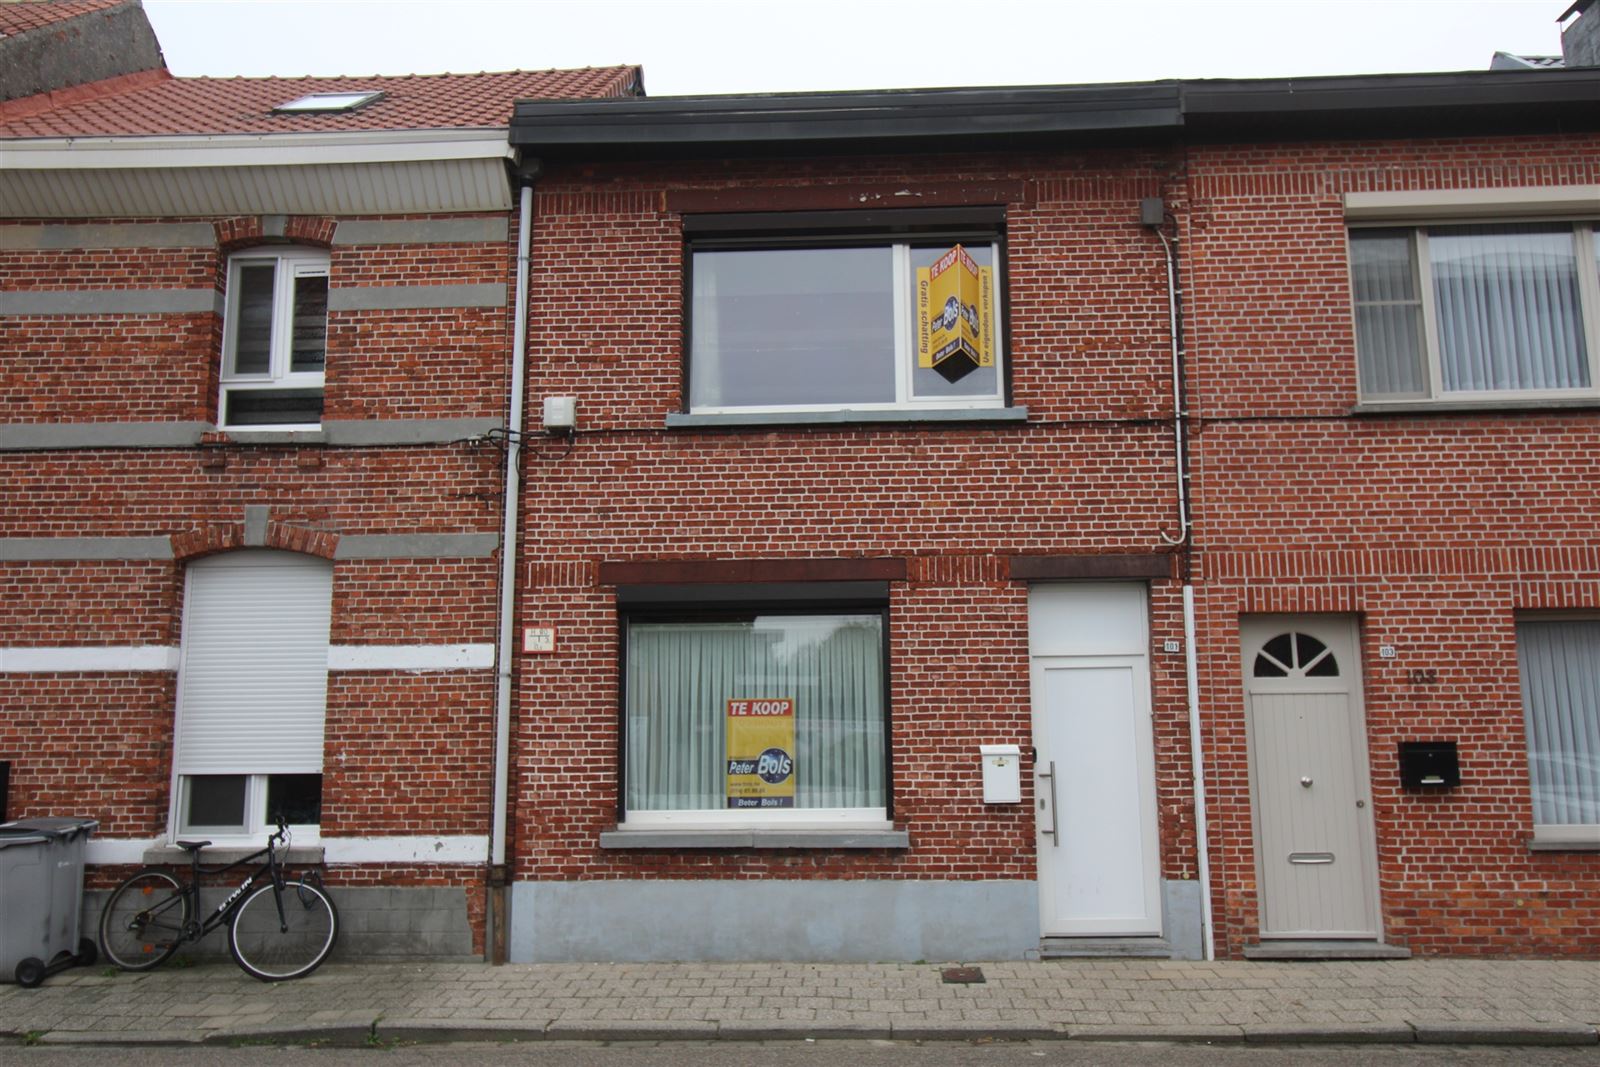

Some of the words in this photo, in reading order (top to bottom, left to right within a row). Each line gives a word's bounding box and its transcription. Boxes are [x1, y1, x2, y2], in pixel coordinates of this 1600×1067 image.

[931, 263, 940, 279] TE
[940, 249, 958, 273] KOOP
[921, 280, 929, 308] Gratis
[921, 311, 930, 354] schatting
[1381, 647, 1394, 656] 103
[730, 702, 748, 715] TE
[751, 702, 790, 715] KOOP
[729, 761, 755, 774] Peter
[757, 755, 791, 774] Bols
[761, 799, 778, 807] Bols
